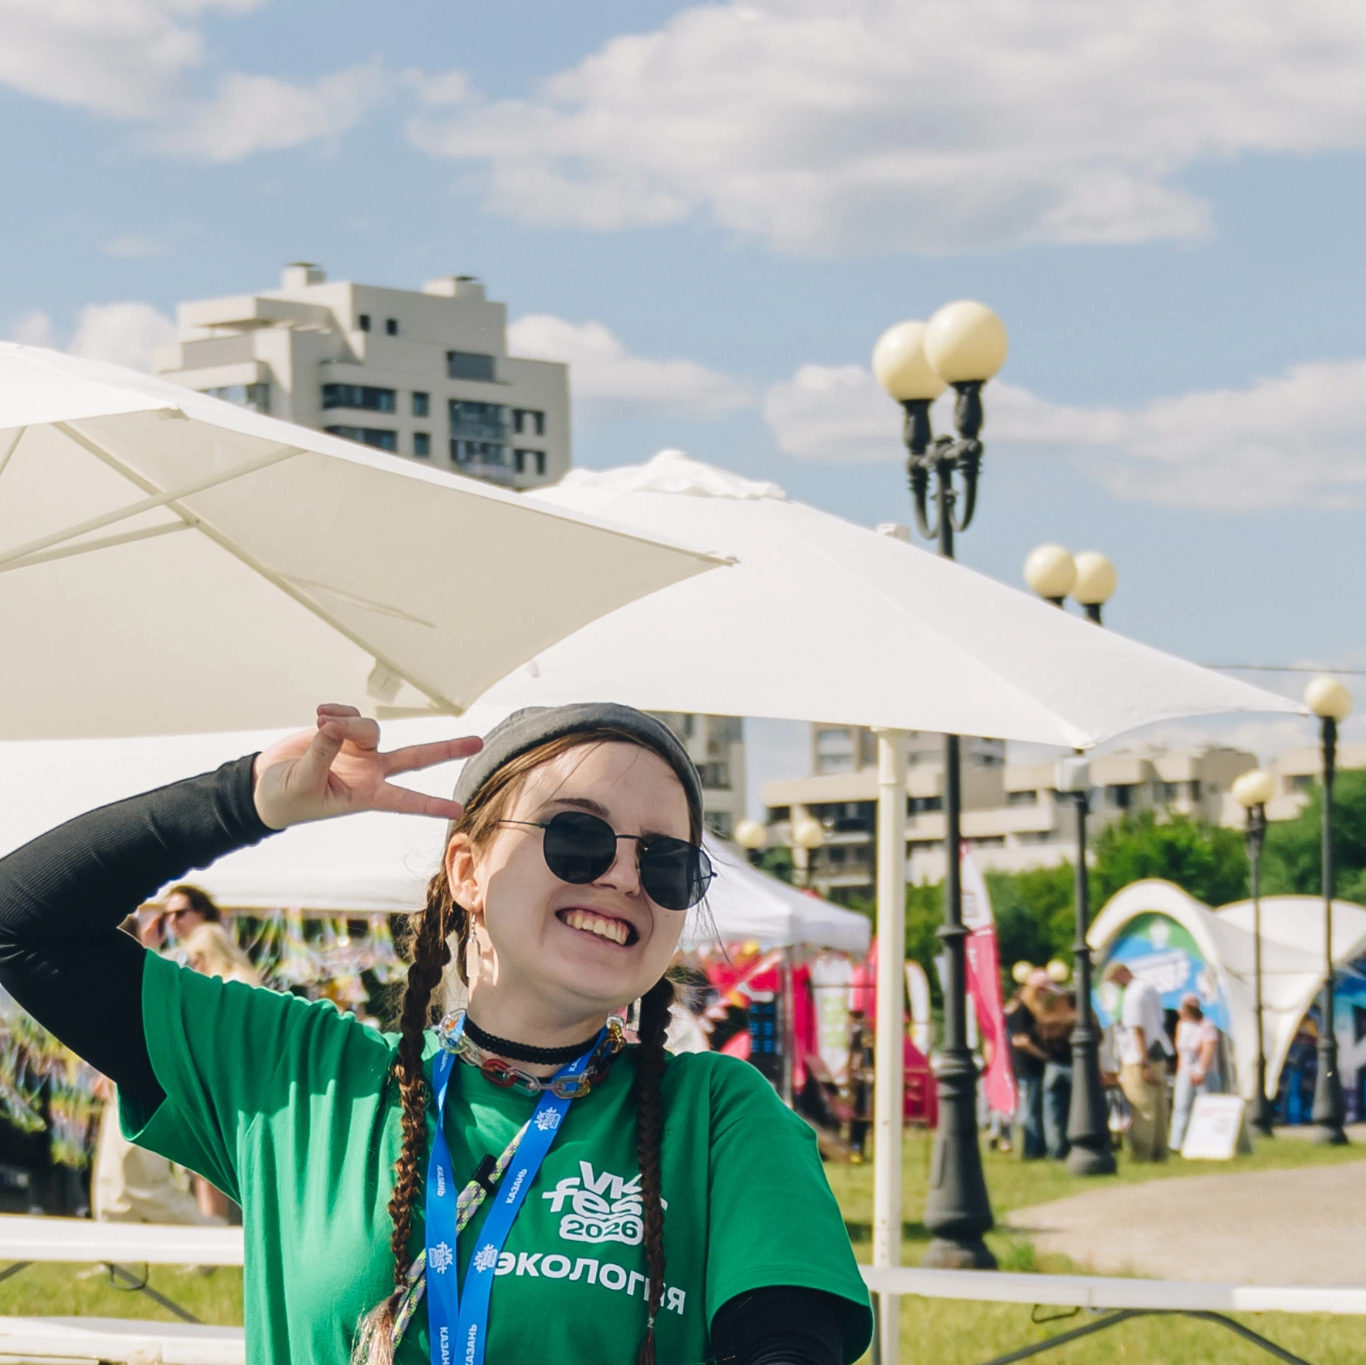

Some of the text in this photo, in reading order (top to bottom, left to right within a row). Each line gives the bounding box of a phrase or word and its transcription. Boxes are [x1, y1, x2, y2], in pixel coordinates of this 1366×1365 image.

[506, 1169, 528, 1204] КАЗАНЬ
[542, 1177, 668, 1218] fes
[579, 1161, 643, 1199] VK
[566, 1219, 638, 1239] 2026
[436, 1241, 448, 1274] fest
